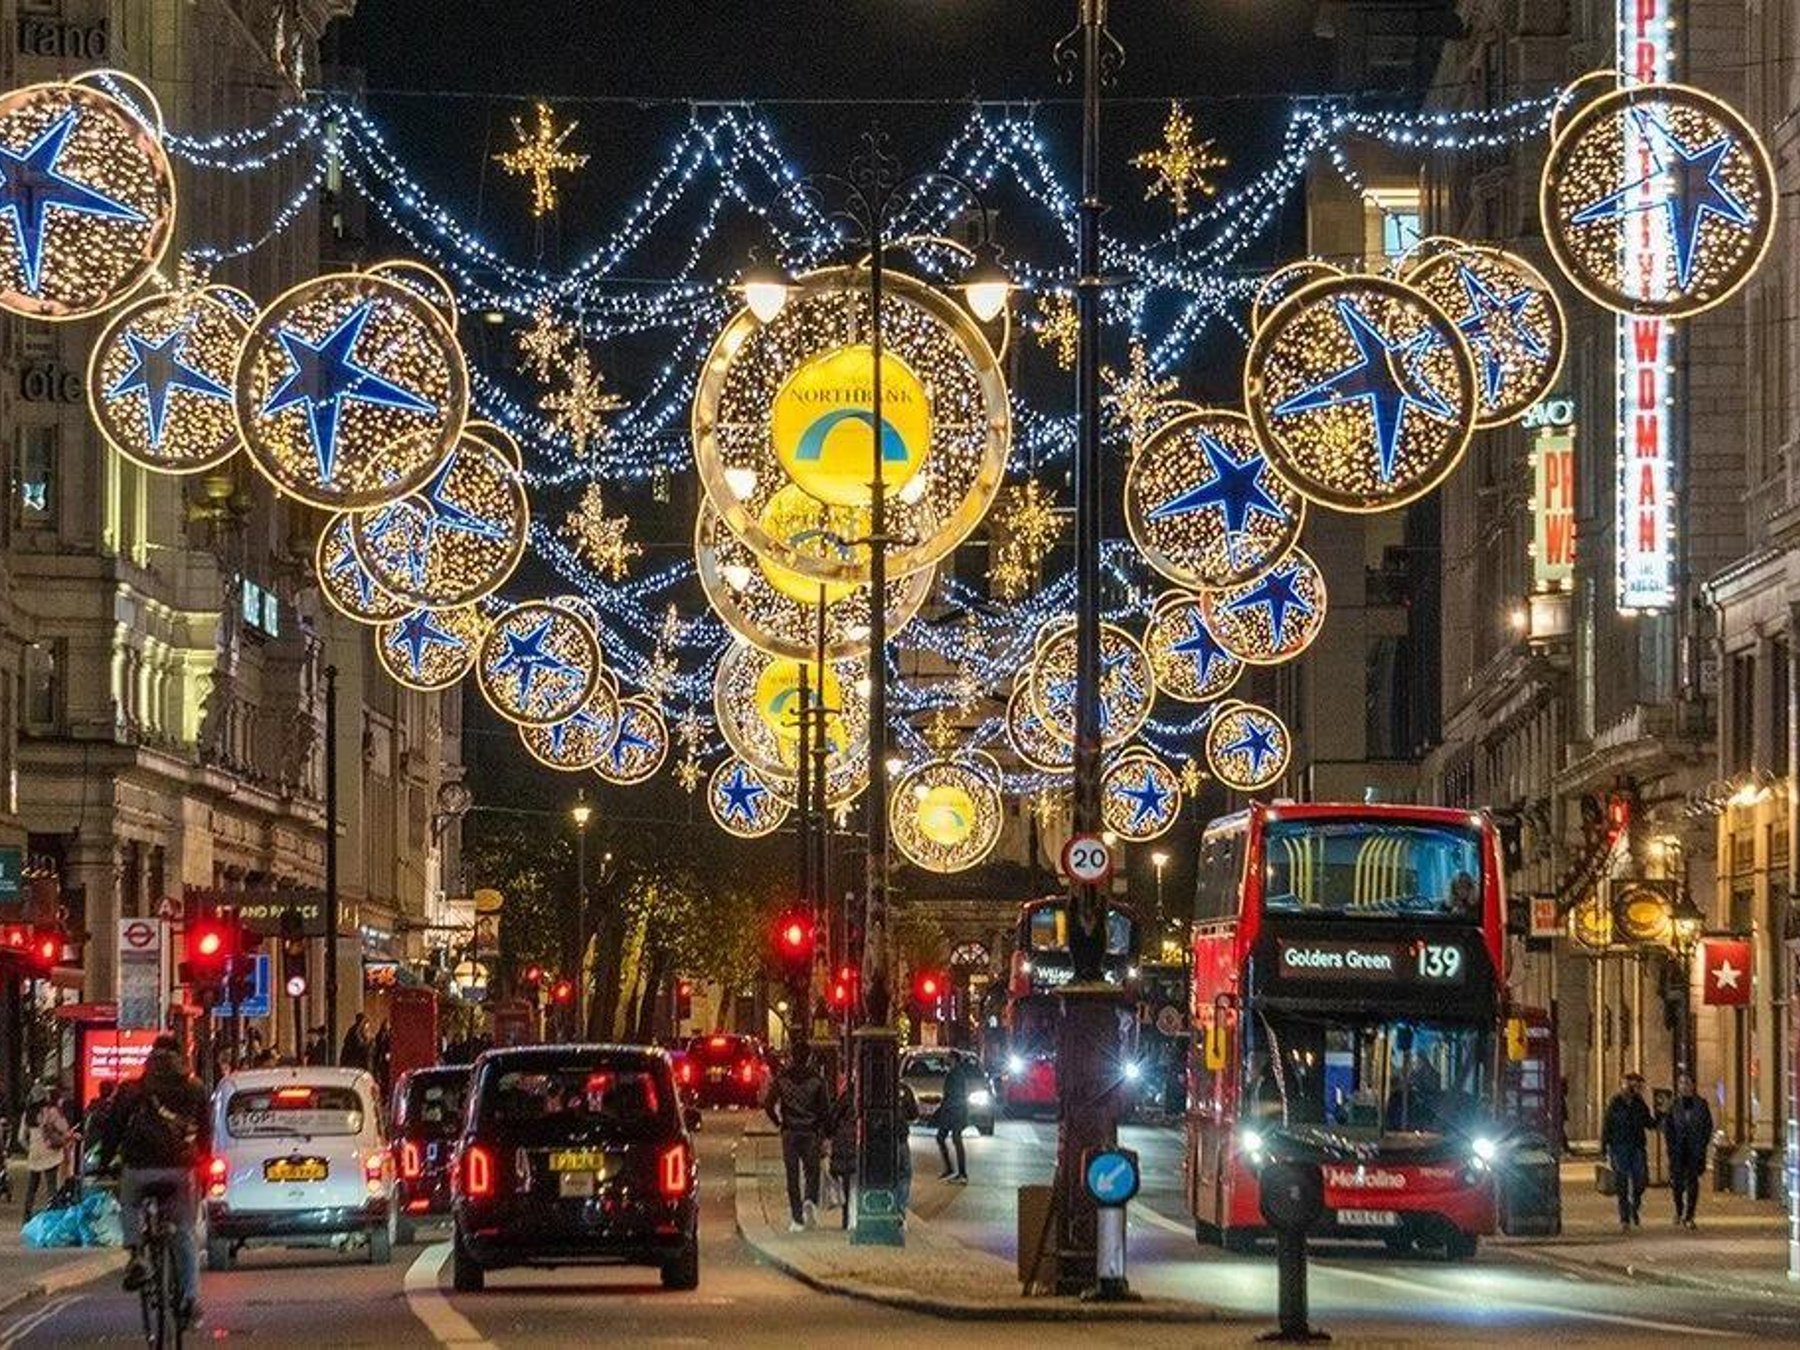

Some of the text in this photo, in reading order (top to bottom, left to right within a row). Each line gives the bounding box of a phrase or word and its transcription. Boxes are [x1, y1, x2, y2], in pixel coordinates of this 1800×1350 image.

[1636, 0, 1656, 299] PRTTY
[791, 388, 912, 404] NORTHBNK
[1521, 400, 1575, 428] SAVO
[1634, 320, 1659, 552] WOMAN
[1073, 849, 1106, 868] 20
[214, 905, 319, 919] STAND PACE
[1285, 946, 1461, 977] Golders Green 139
[1329, 1168, 1406, 1188] Meoline
